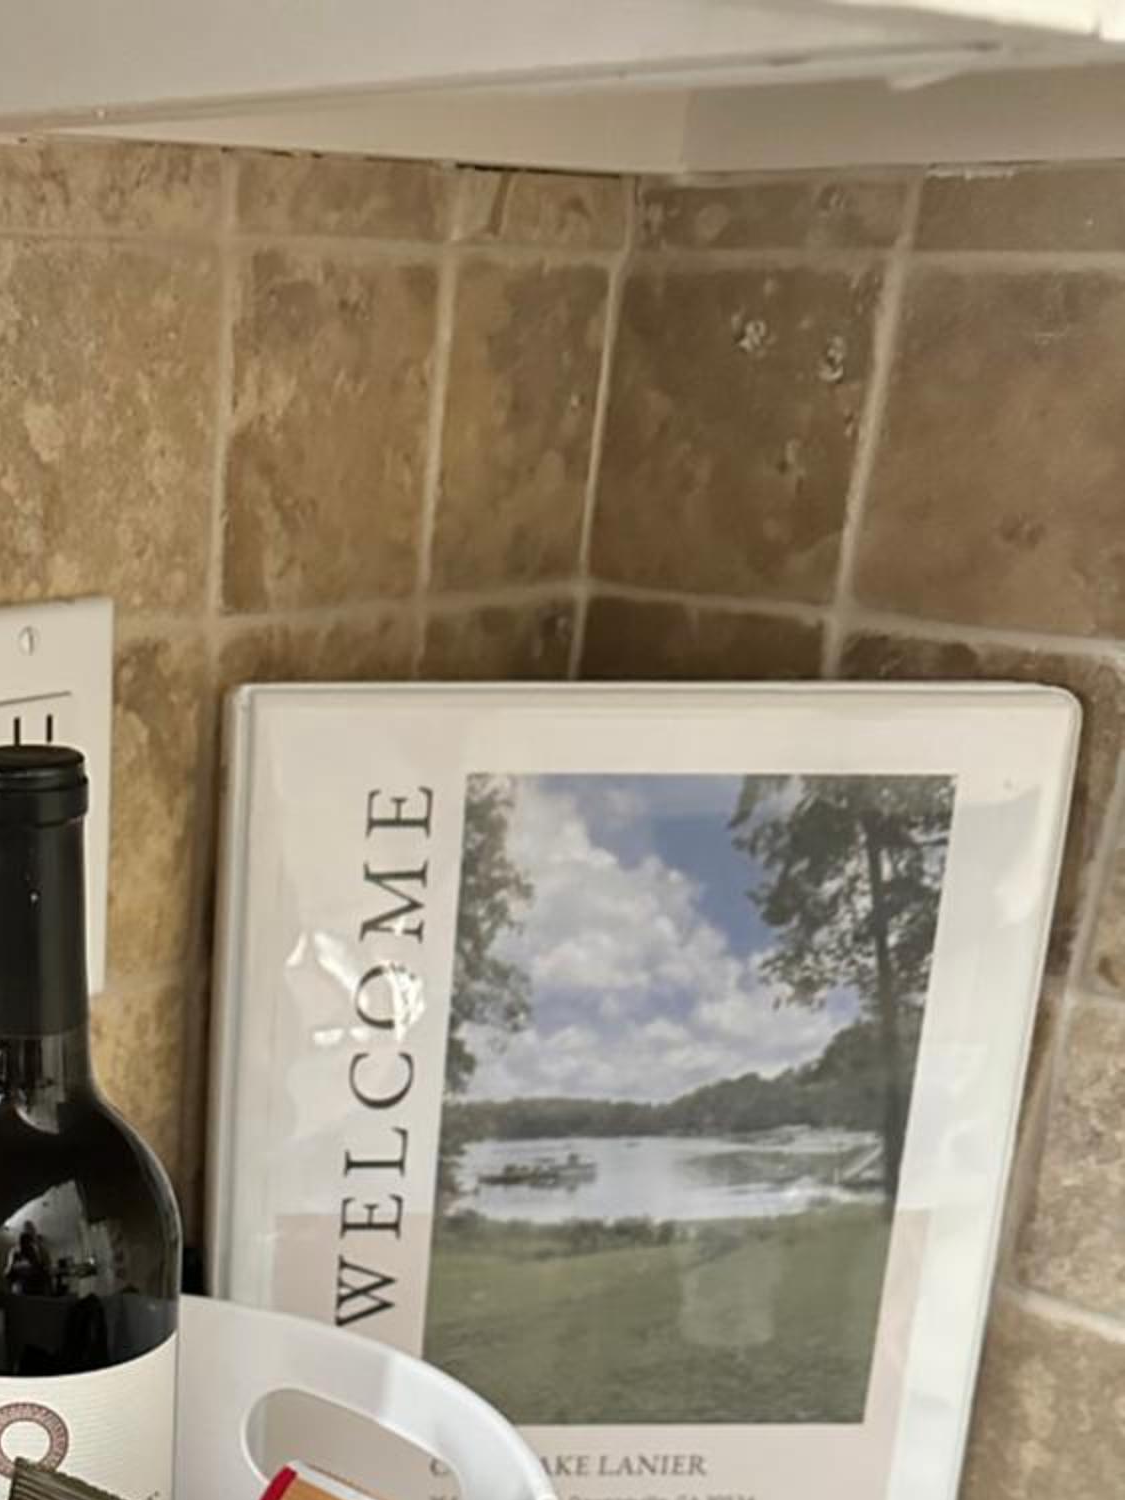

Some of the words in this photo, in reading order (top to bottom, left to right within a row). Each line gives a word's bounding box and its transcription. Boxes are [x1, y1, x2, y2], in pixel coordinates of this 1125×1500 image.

[334, 786, 434, 1328] WELCOME
[538, 1454, 590, 1477] AKE
[598, 1454, 708, 1477] LANIER
